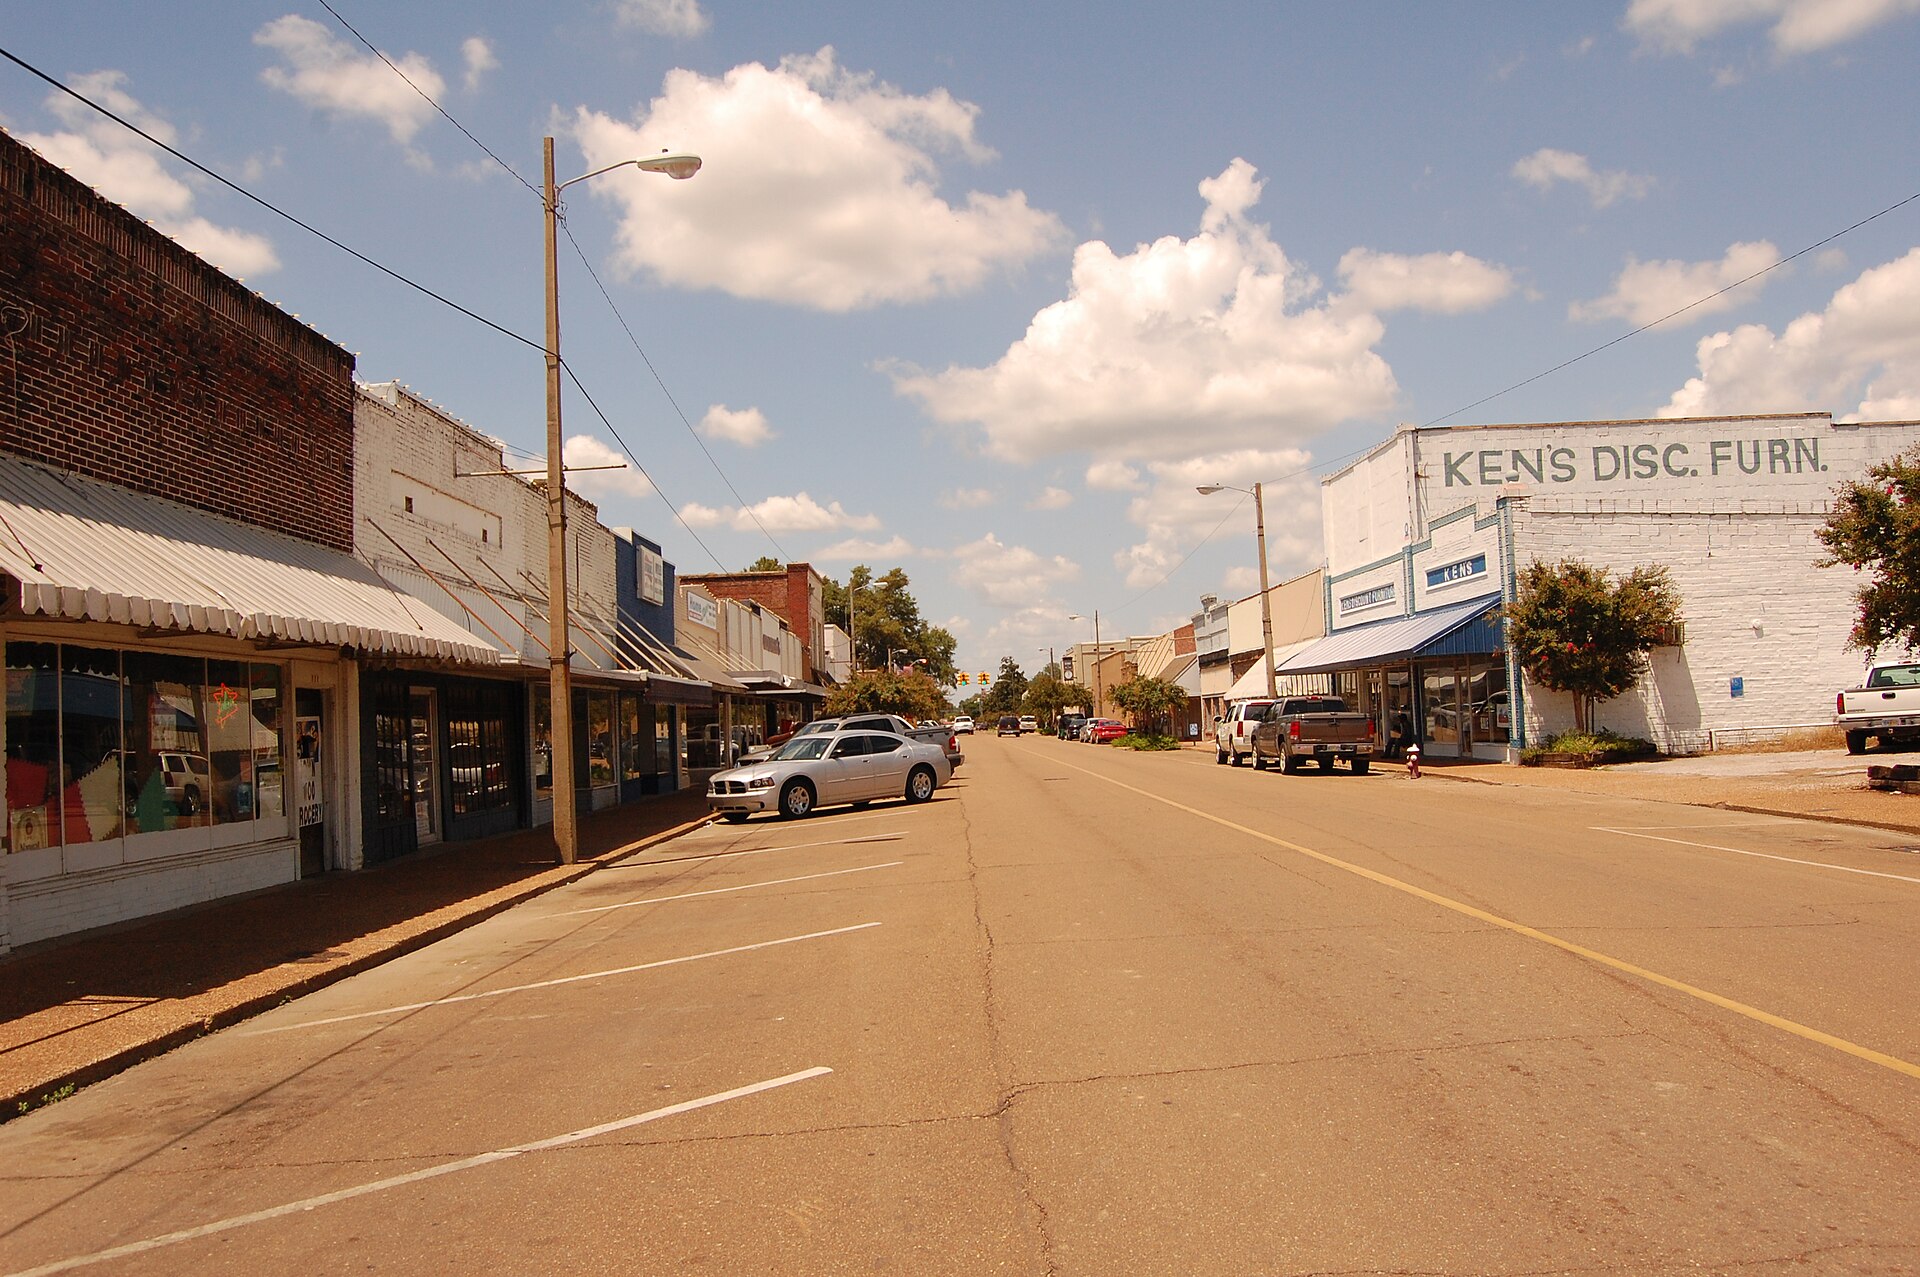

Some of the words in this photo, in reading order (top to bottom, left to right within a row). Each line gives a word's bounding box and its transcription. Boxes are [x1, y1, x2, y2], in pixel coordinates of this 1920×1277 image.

[1443, 444, 1577, 487] KEN'S
[1592, 443, 1698, 482] DISC.
[1710, 437, 1829, 476] FURN.
